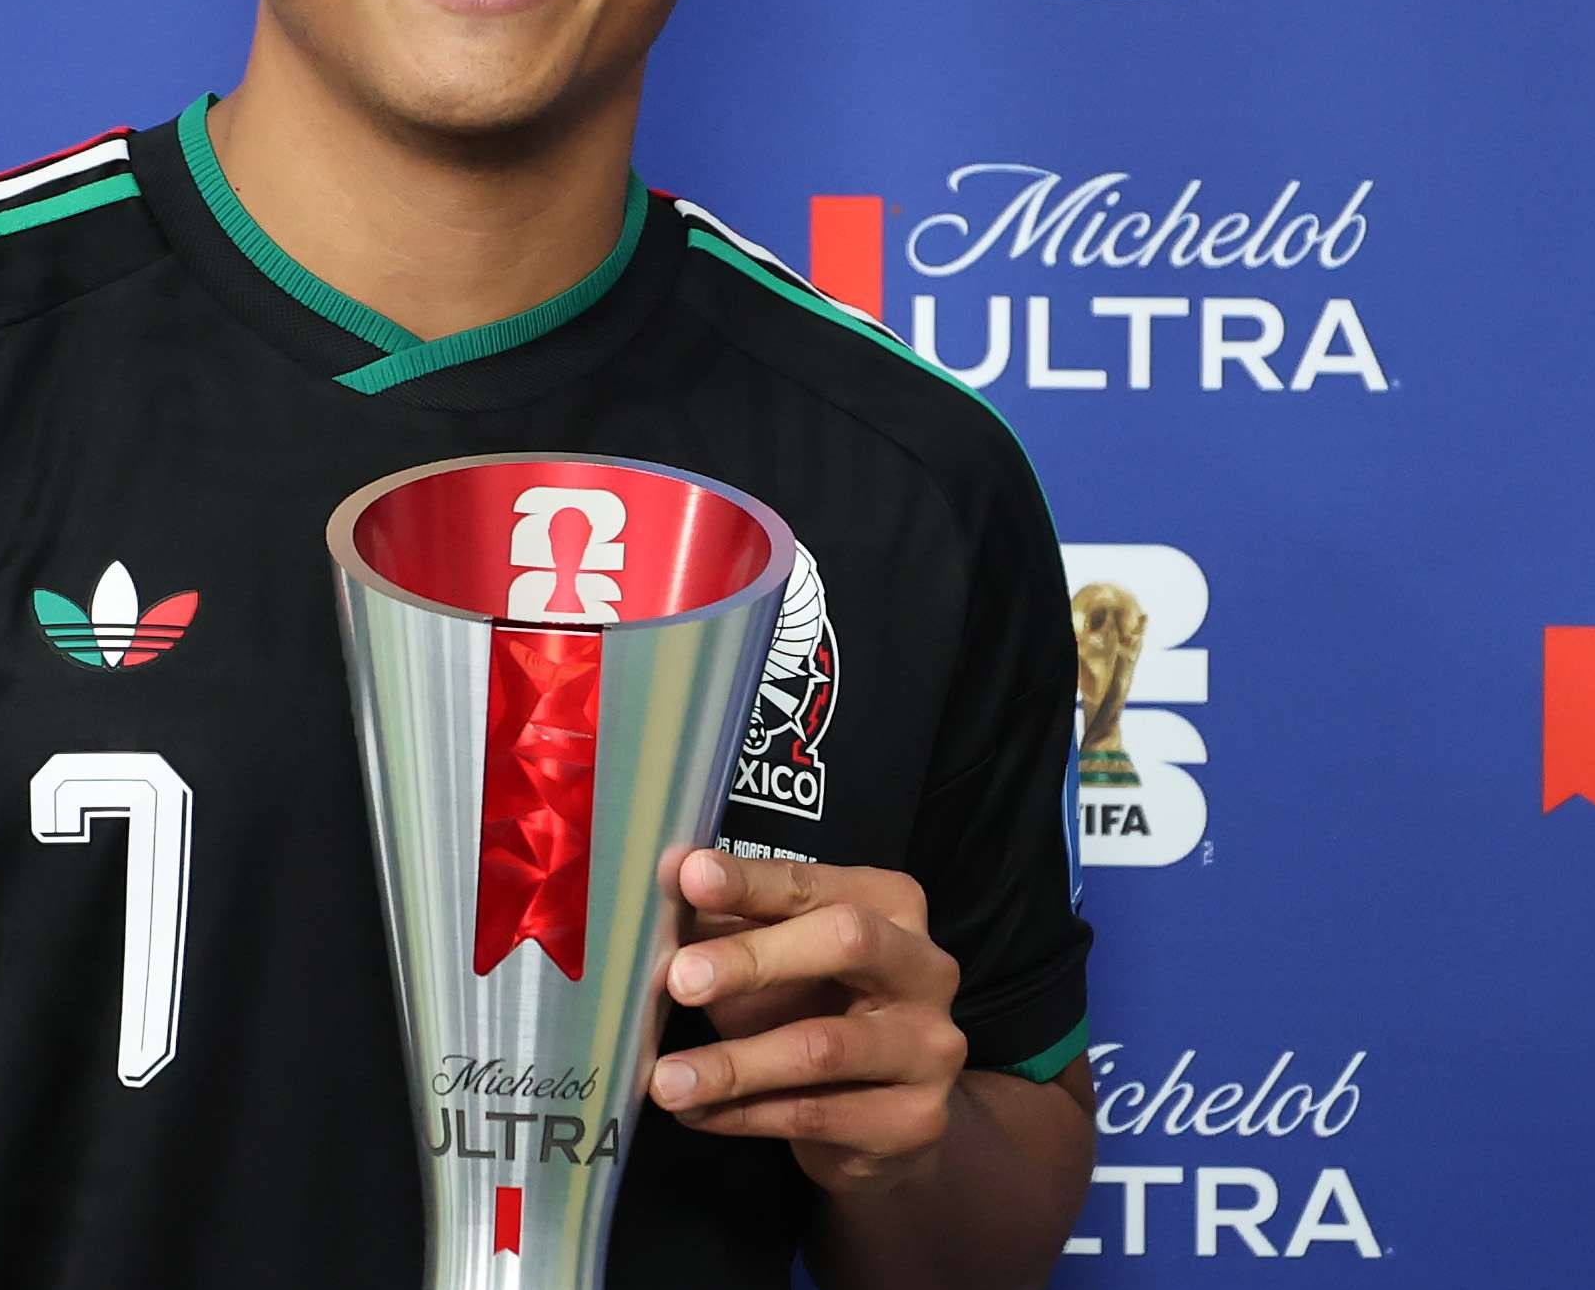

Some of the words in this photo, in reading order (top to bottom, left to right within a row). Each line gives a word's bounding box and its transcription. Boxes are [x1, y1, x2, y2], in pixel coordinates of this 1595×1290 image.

[905, 164, 1373, 277] Michelob
[913, 295, 1388, 392] ULTRA
[734, 757, 819, 806] XICO
[1080, 804, 1151, 836] IFA
[31, 753, 193, 1087] 7
[432, 1054, 599, 1101] Michelob
[1088, 1043, 1367, 1138] chelob
[1062, 1165, 1382, 1258] TRA
